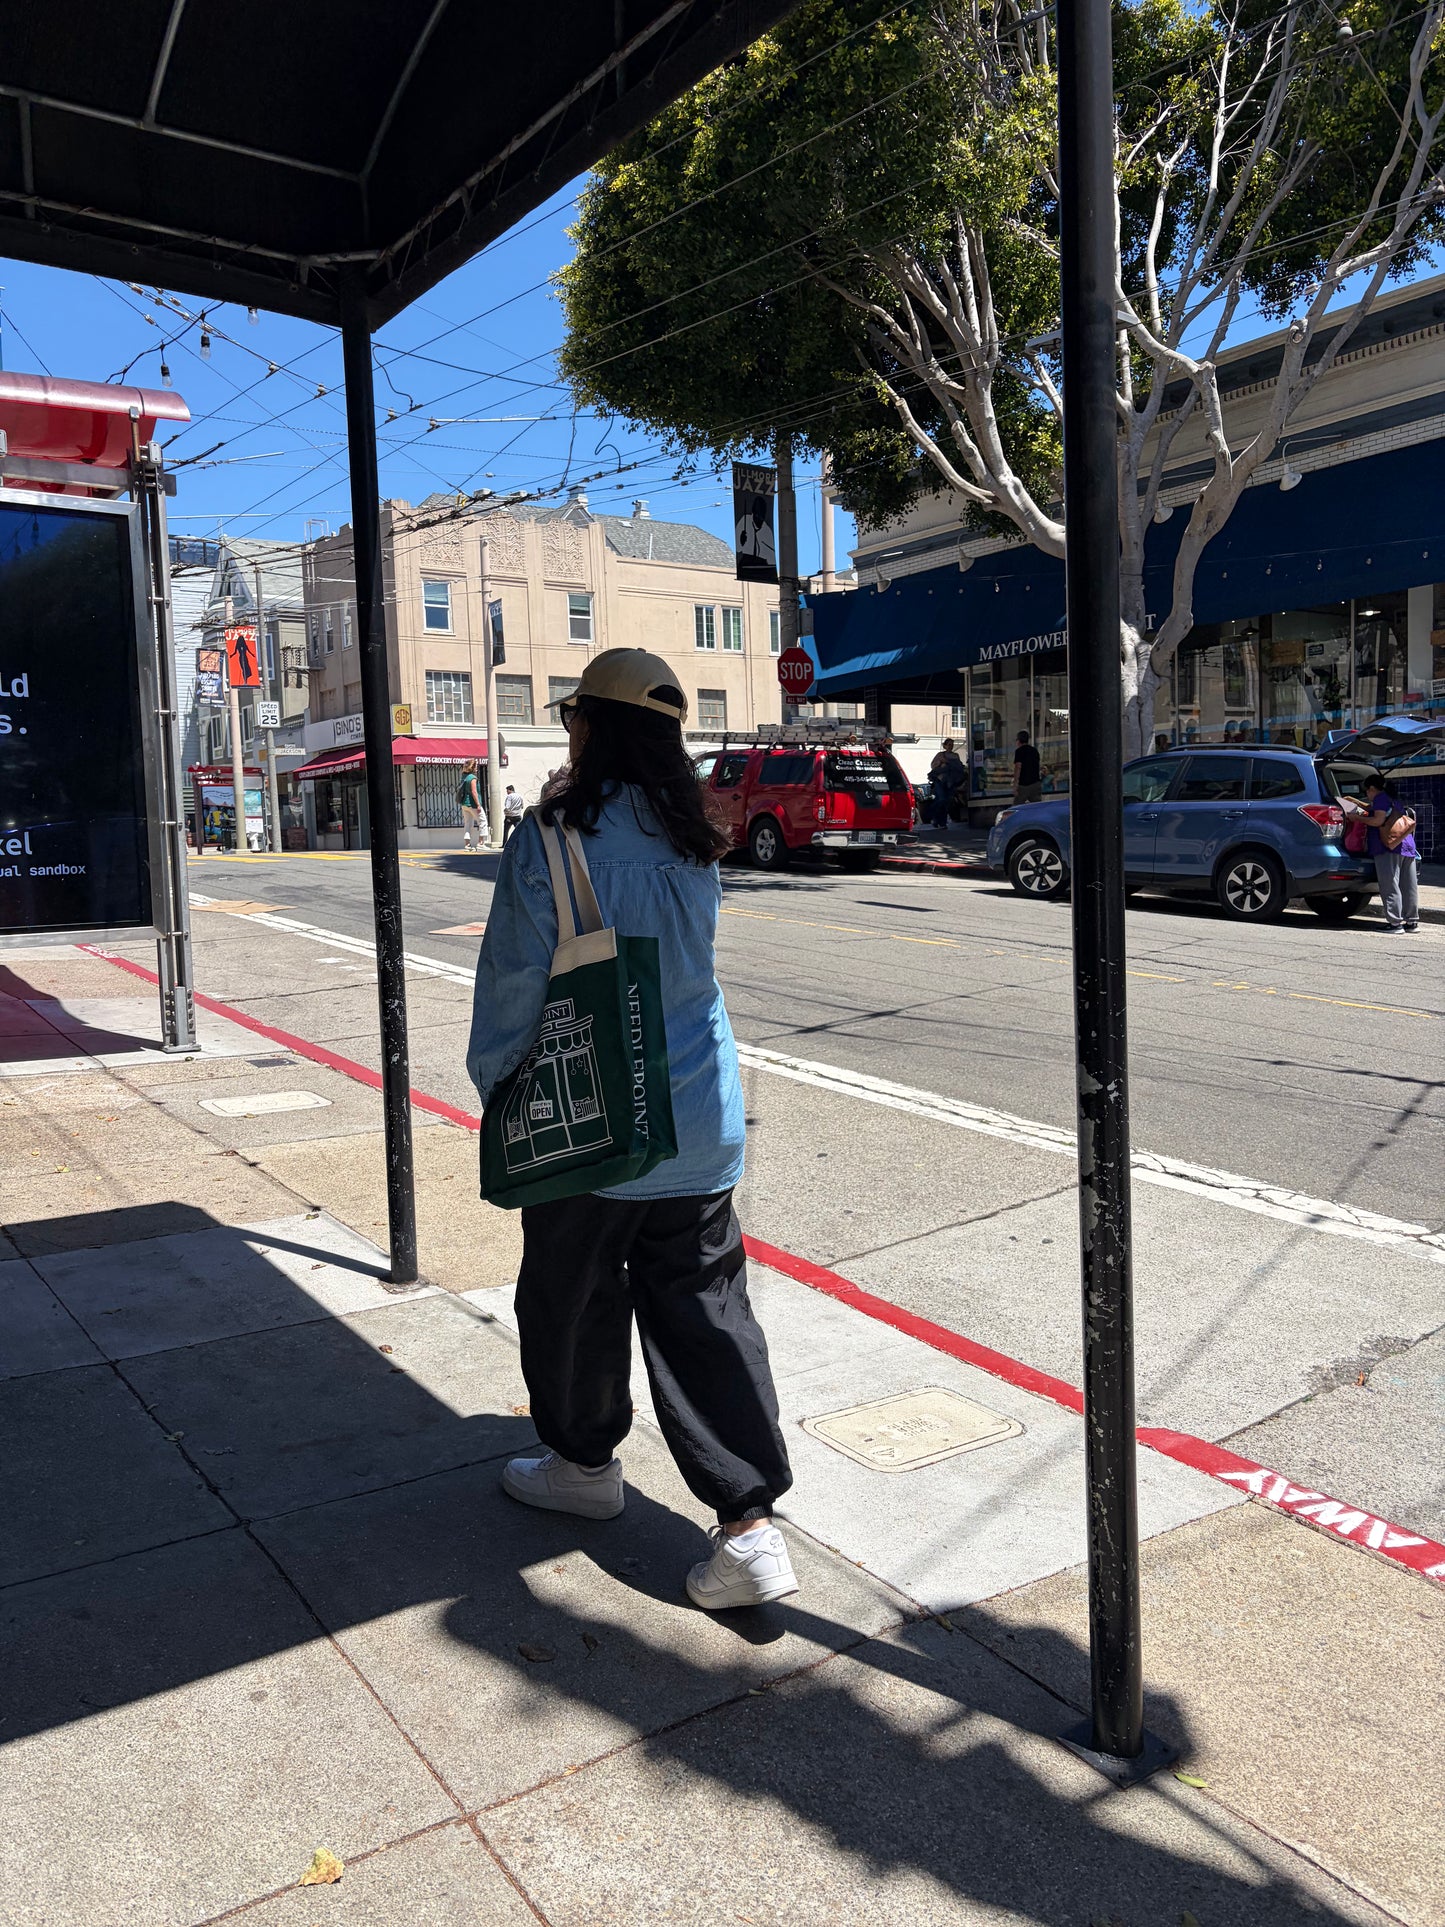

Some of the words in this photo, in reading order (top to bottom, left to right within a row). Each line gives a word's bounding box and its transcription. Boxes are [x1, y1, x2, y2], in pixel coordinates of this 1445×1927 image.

[734, 475, 775, 497] JAZZ
[226, 630, 256, 641] JAZZ
[780, 662, 812, 680] STOP
[262, 714, 278, 725] 25
[335, 717, 362, 736] GINO'S
[29, 864, 86, 876] sandbox
[532, 1106, 552, 1119] OPEN
[1216, 1469, 1428, 1550] AWAY
